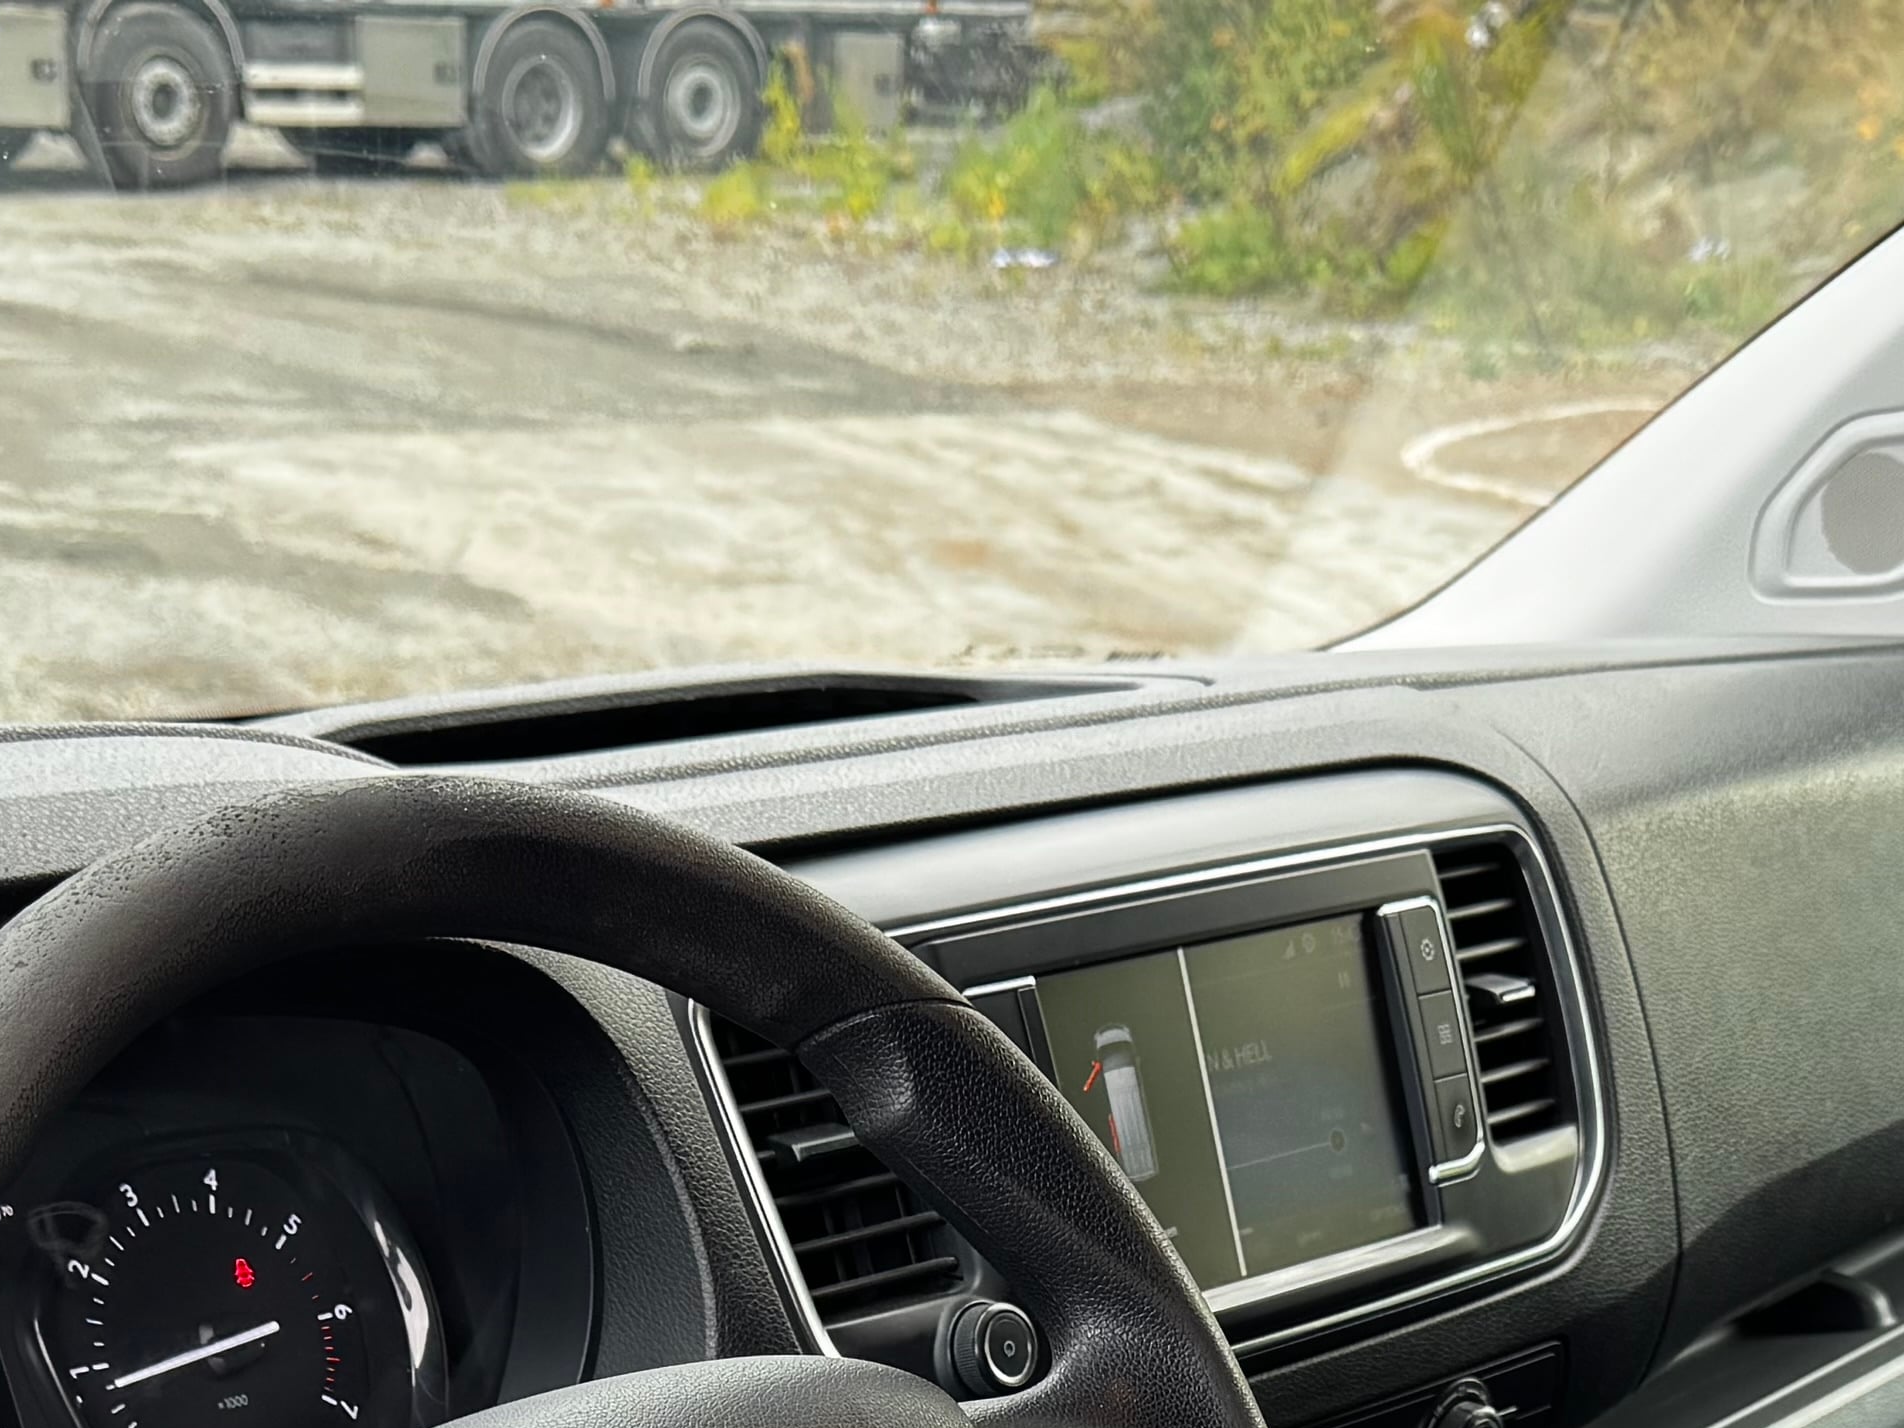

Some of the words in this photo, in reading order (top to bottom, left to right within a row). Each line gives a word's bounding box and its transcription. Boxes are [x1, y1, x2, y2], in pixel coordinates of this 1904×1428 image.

[202, 1168, 219, 1191] 4
[118, 1182, 138, 1208] 3
[282, 1213, 302, 1236] 5
[67, 1259, 91, 1280] 2
[333, 1303, 354, 1321] 6
[68, 1365, 91, 1380] 1
[339, 1399, 360, 1421] 7
